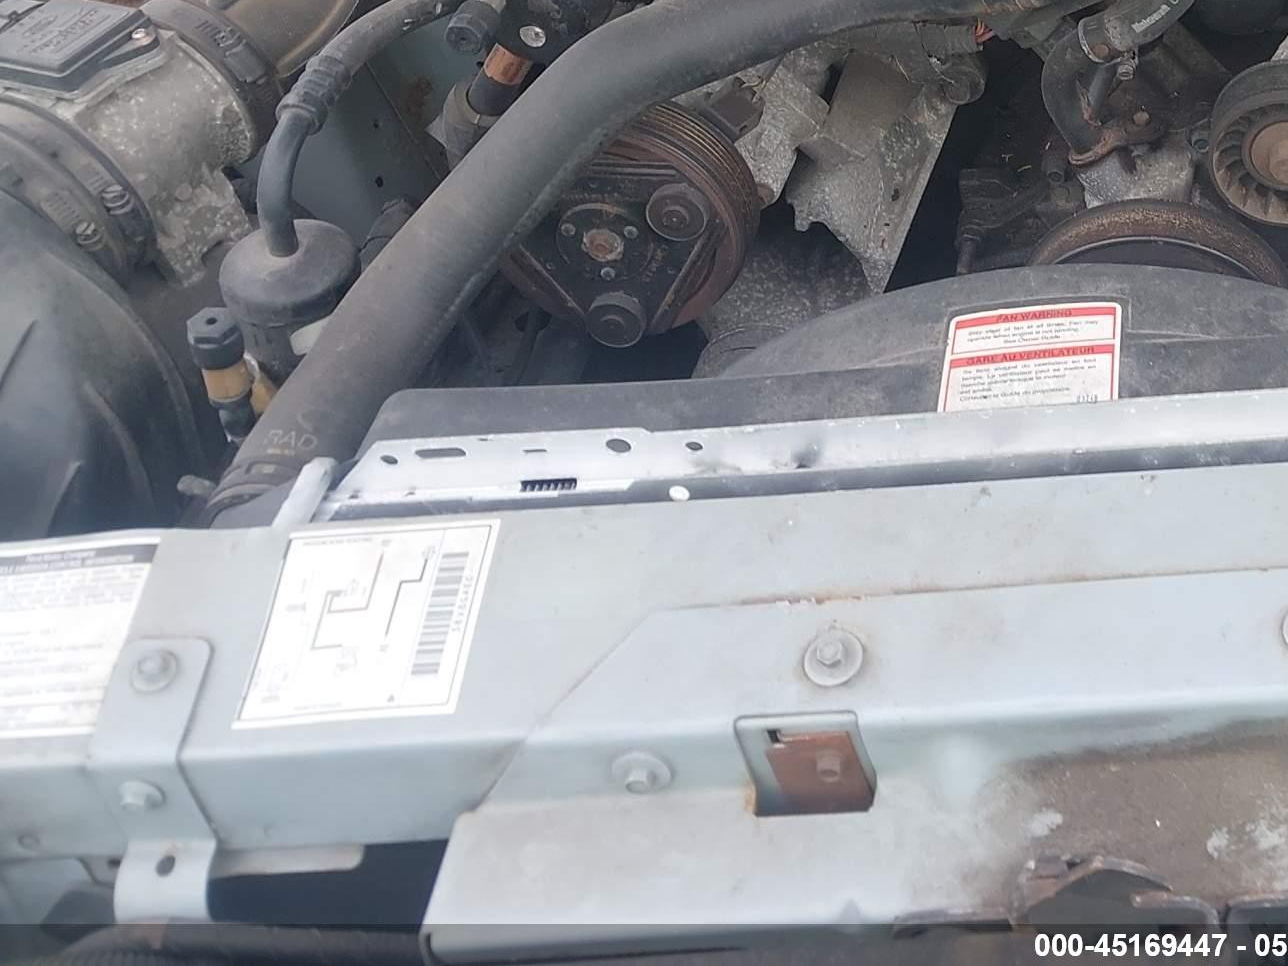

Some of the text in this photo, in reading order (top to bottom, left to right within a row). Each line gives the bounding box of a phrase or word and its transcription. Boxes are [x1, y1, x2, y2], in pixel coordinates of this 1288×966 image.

[996, 309, 1073, 323] FAN WARNING
[966, 346, 1096, 366] GARE AU VENTILATEUR
